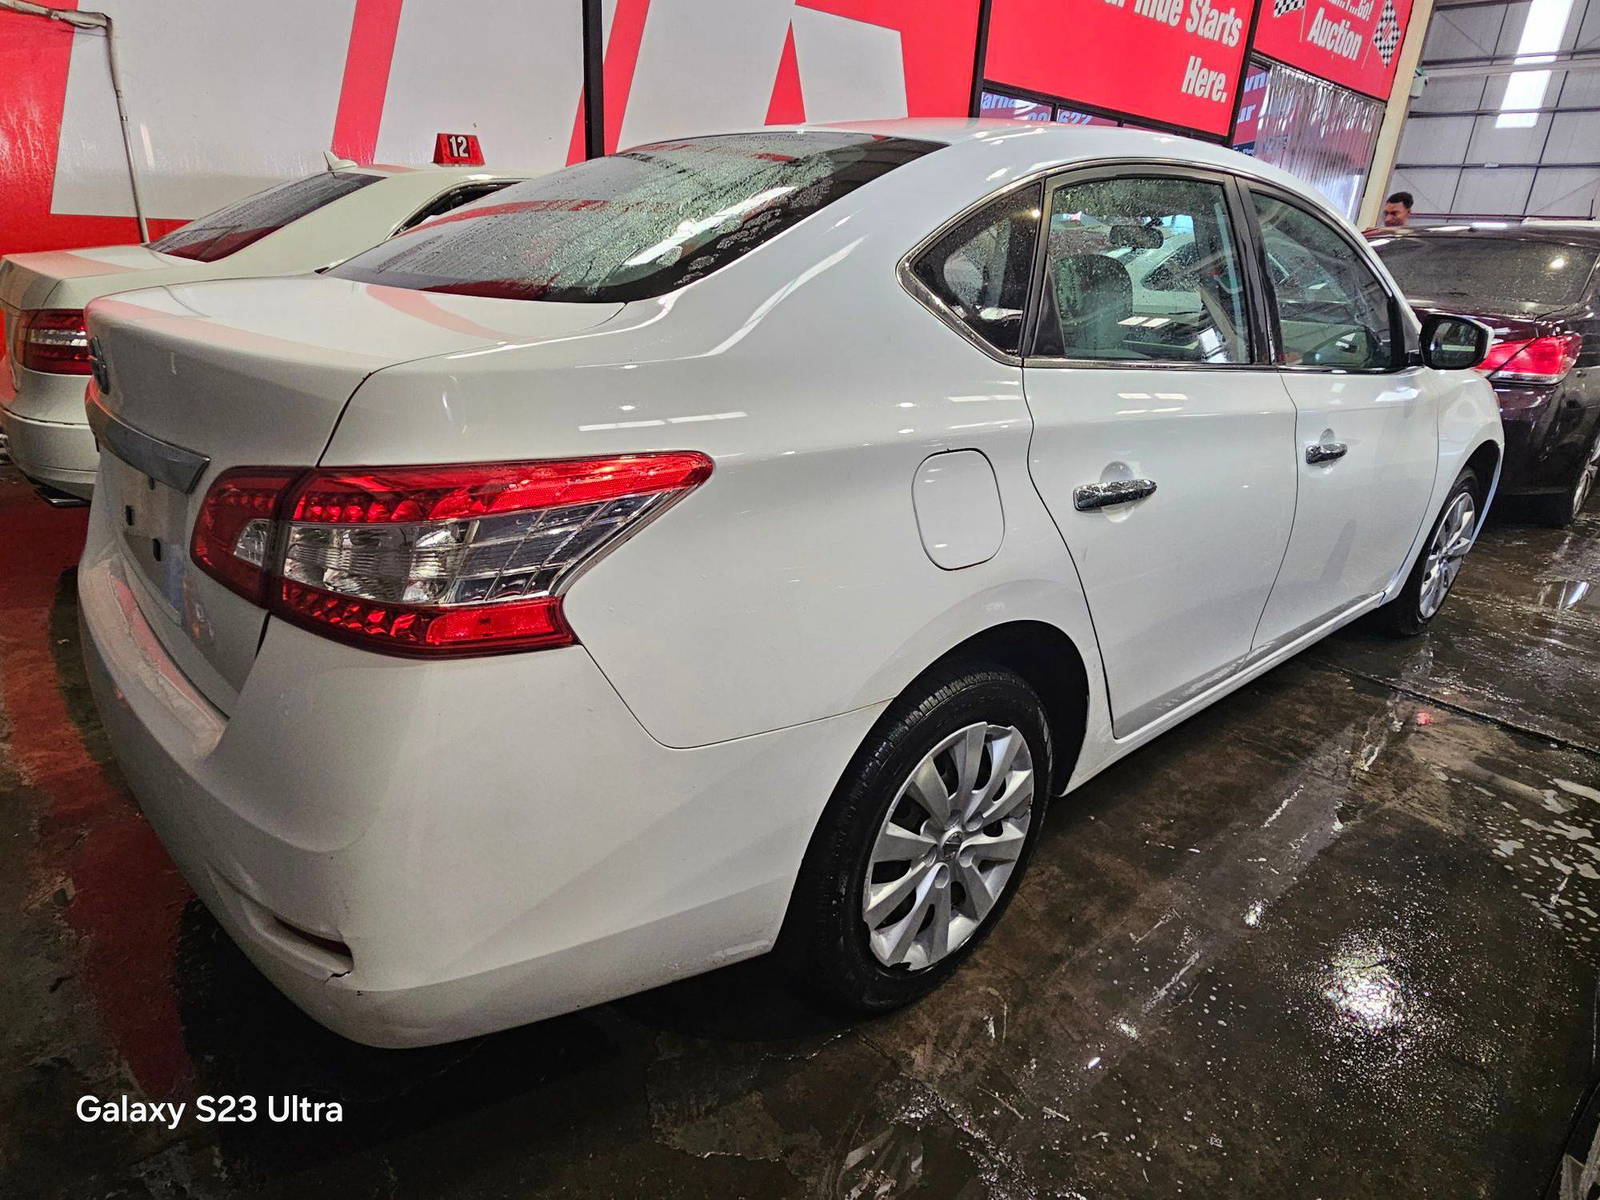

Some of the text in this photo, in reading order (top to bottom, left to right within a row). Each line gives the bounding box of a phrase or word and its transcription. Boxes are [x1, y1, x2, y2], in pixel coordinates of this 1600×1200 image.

[1185, 0, 1243, 48] Starts
[1306, 6, 1363, 61] Auction
[1180, 55, 1228, 103] Here.
[449, 135, 469, 158] 12
